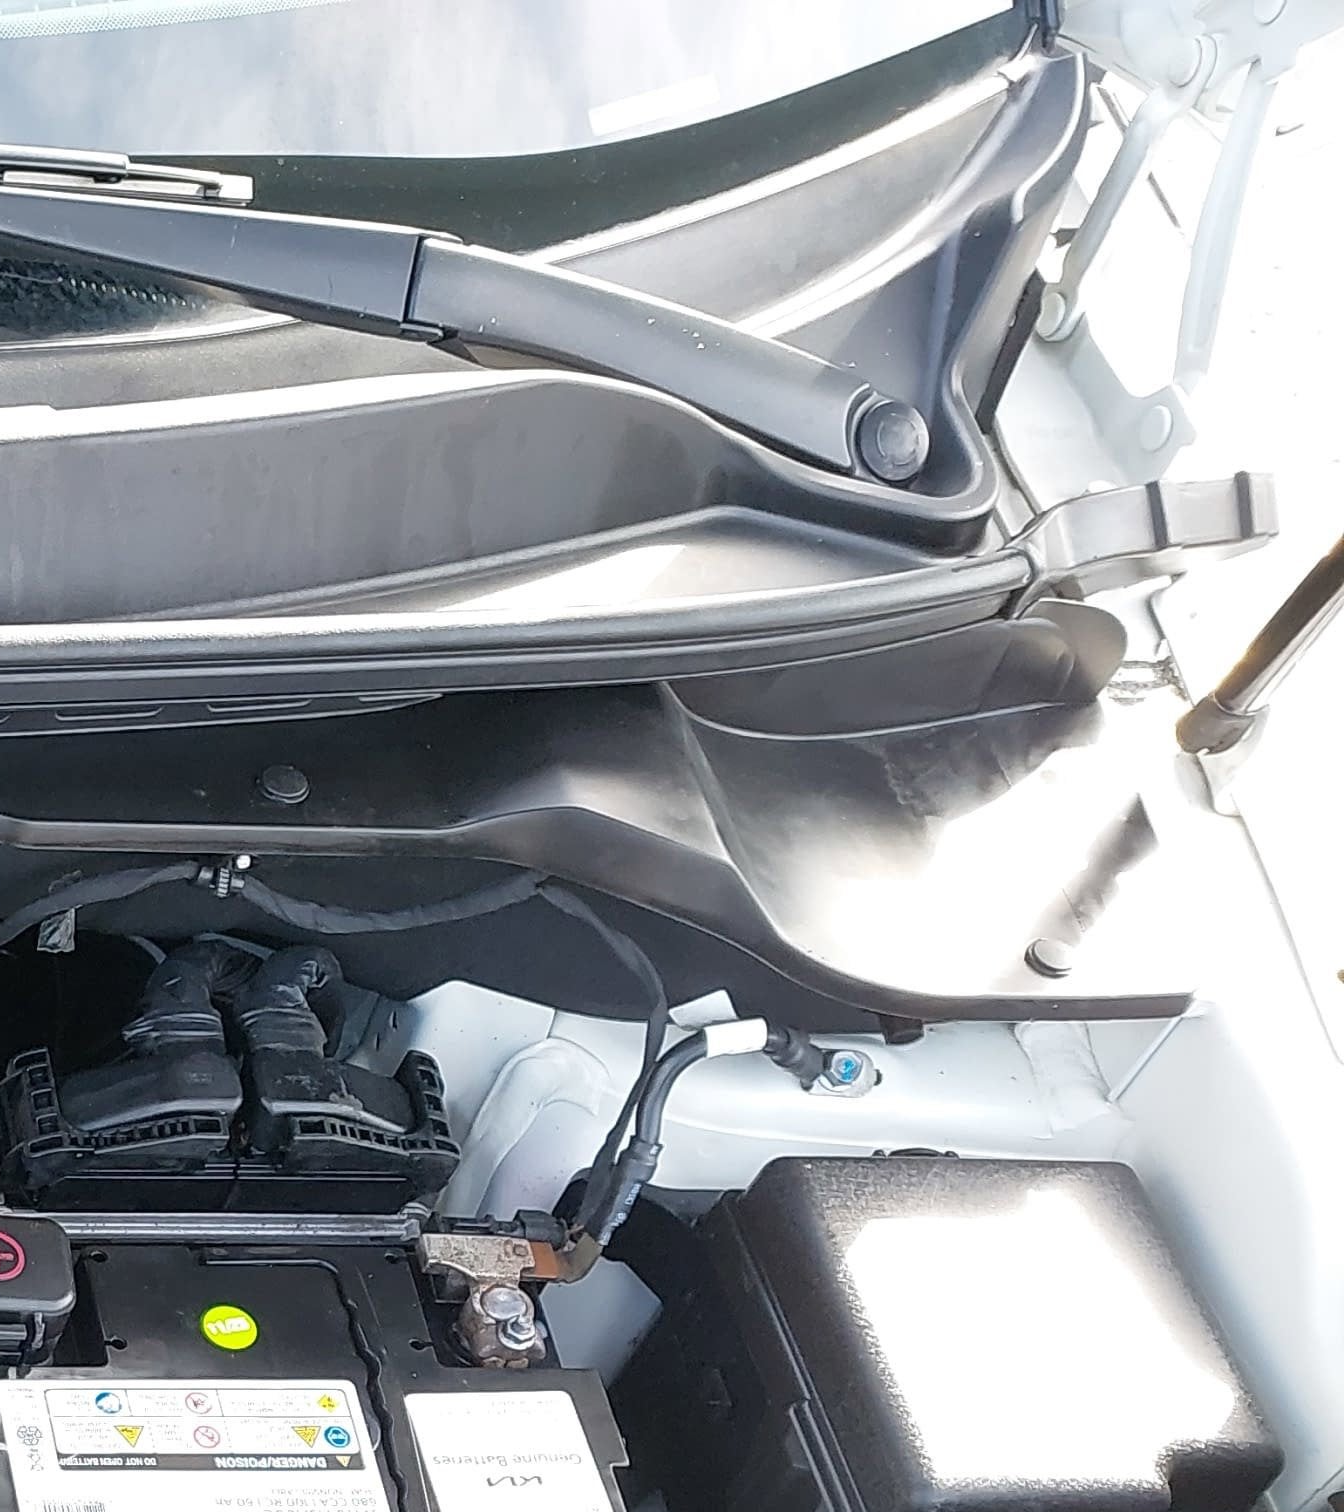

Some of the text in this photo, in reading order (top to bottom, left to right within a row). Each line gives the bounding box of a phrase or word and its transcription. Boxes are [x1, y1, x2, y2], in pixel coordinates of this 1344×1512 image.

[125, 1457, 142, 1466] NOT
[144, 1457, 157, 1466] DO
[214, 1456, 327, 1468] DANGER/POISON
